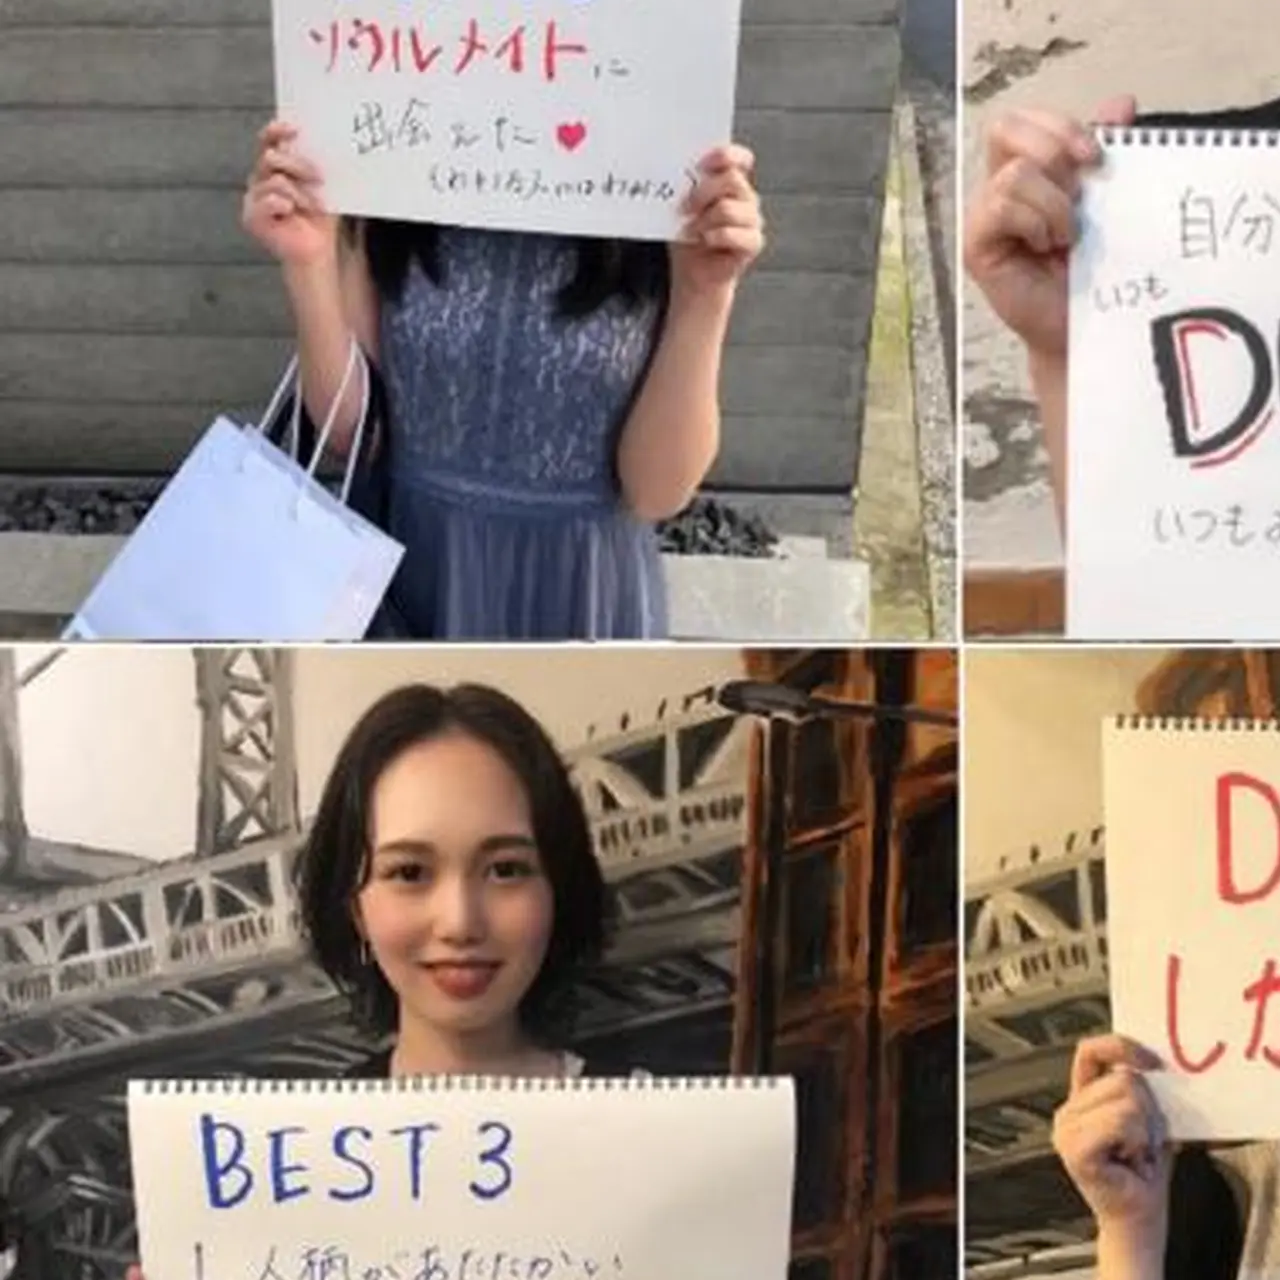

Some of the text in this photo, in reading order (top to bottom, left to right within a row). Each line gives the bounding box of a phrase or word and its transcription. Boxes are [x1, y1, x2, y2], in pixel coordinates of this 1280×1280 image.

[351, 97, 539, 156] 出会えた
[1094, 273, 1169, 310] いつも
[199, 1112, 515, 1210] BEST 3
